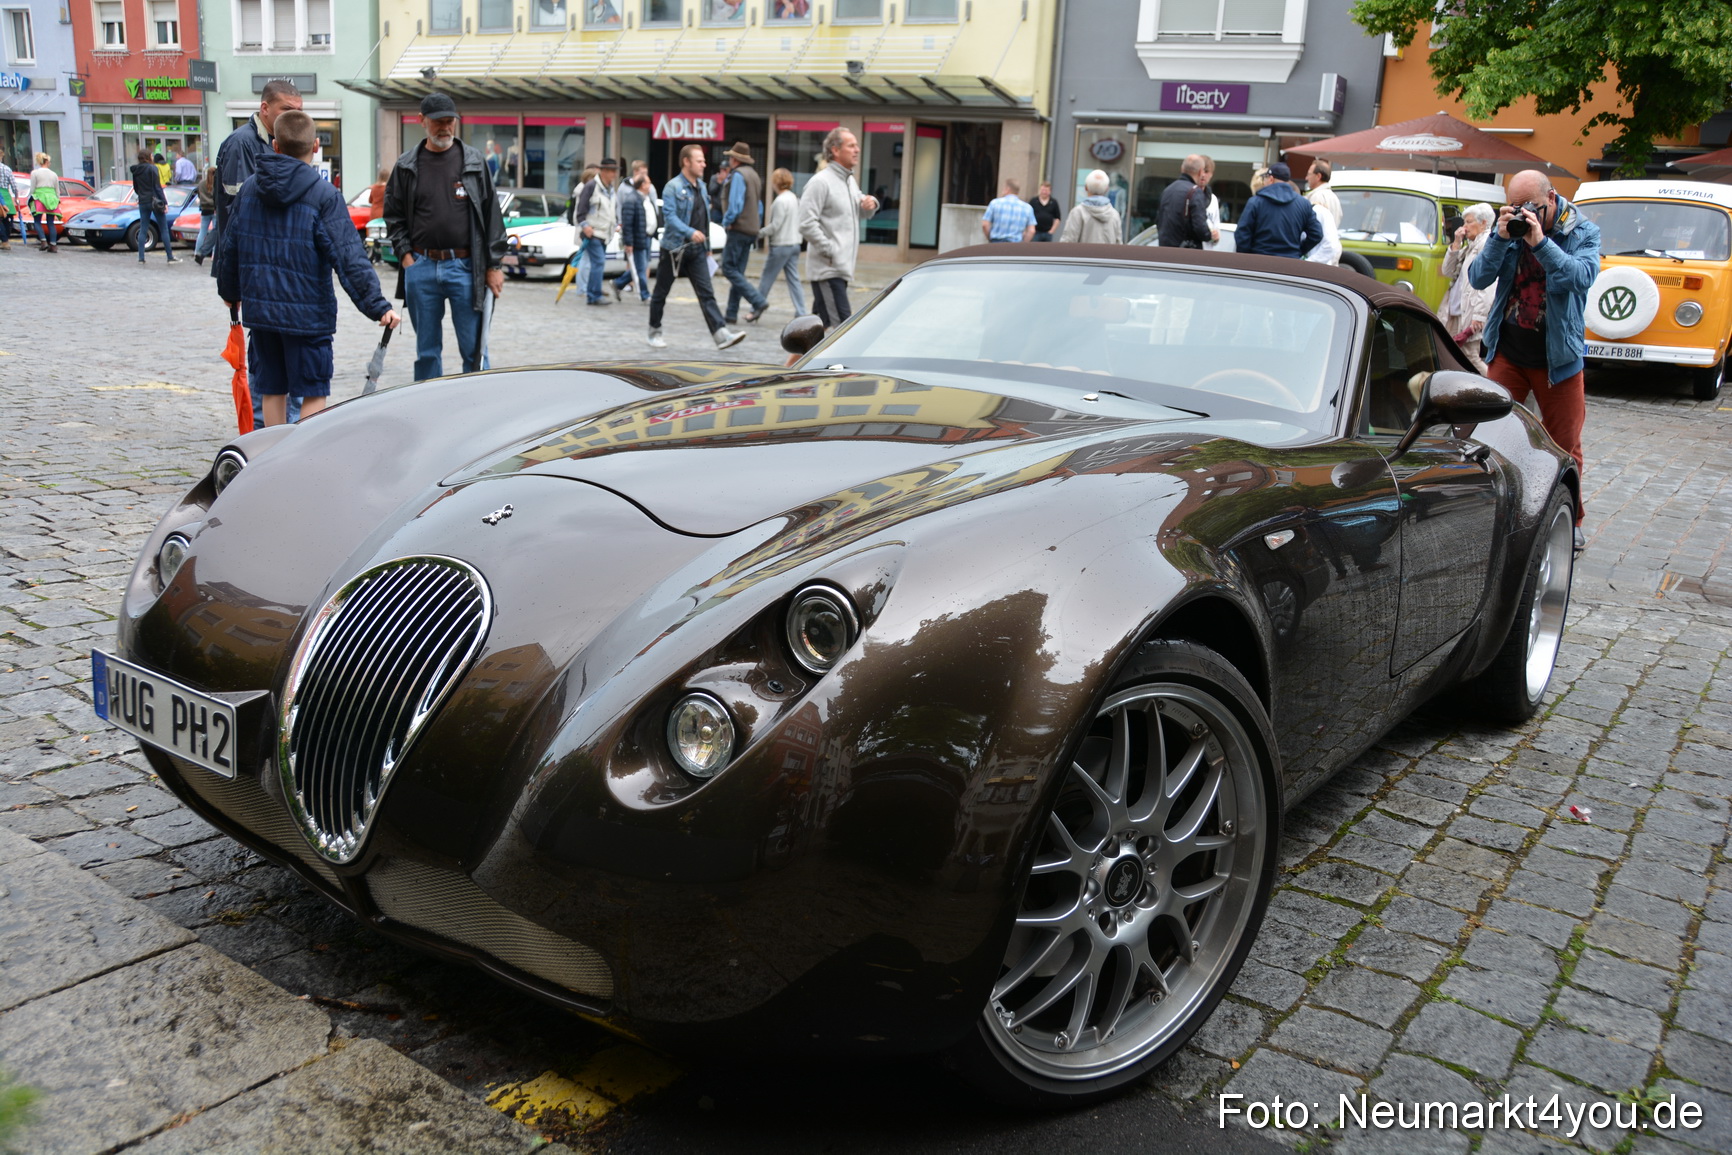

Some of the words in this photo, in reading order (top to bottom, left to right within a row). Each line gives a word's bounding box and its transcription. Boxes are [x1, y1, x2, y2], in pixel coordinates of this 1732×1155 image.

[145, 75, 187, 88] mobilcom
[193, 75, 214, 85] BONITA
[145, 89, 170, 100] debitel
[1176, 84, 1230, 108] liberty
[653, 113, 717, 138] ADLER
[1658, 188, 1714, 199] WESTFALIA
[1587, 345, 1605, 356] GRZ
[1611, 347, 1623, 357] FB
[1624, 348, 1643, 358] 88H
[106, 665, 154, 734] WUG
[171, 693, 231, 769] PH2
